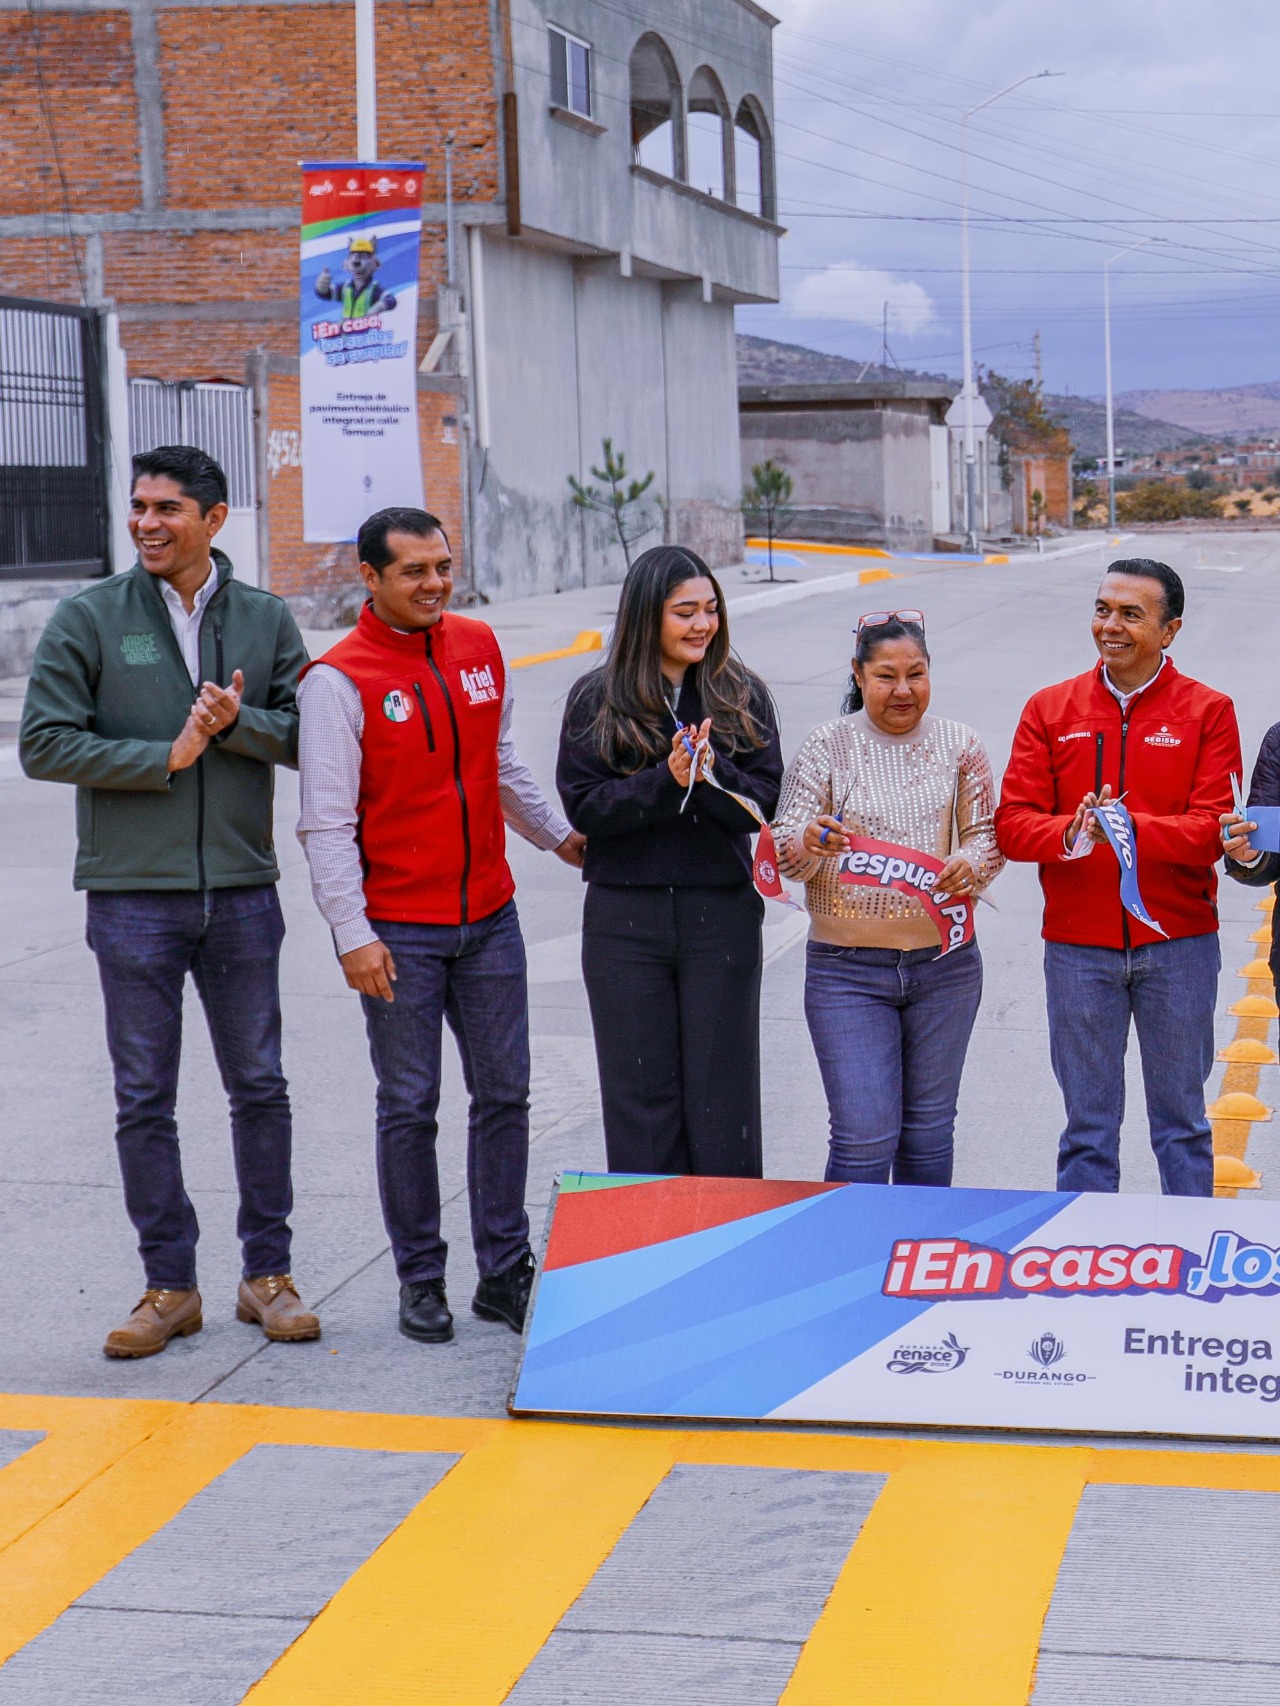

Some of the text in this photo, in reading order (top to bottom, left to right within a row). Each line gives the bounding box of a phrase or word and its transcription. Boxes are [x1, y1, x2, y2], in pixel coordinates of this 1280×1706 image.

[460, 665, 495, 692] Ariel
[886, 1241, 993, 1293] ¡En
[1010, 1248, 1174, 1289] casa
[893, 1350, 953, 1362] renace
[1124, 1327, 1273, 1367] Entrega
[1002, 1370, 1087, 1383] DURANGO
